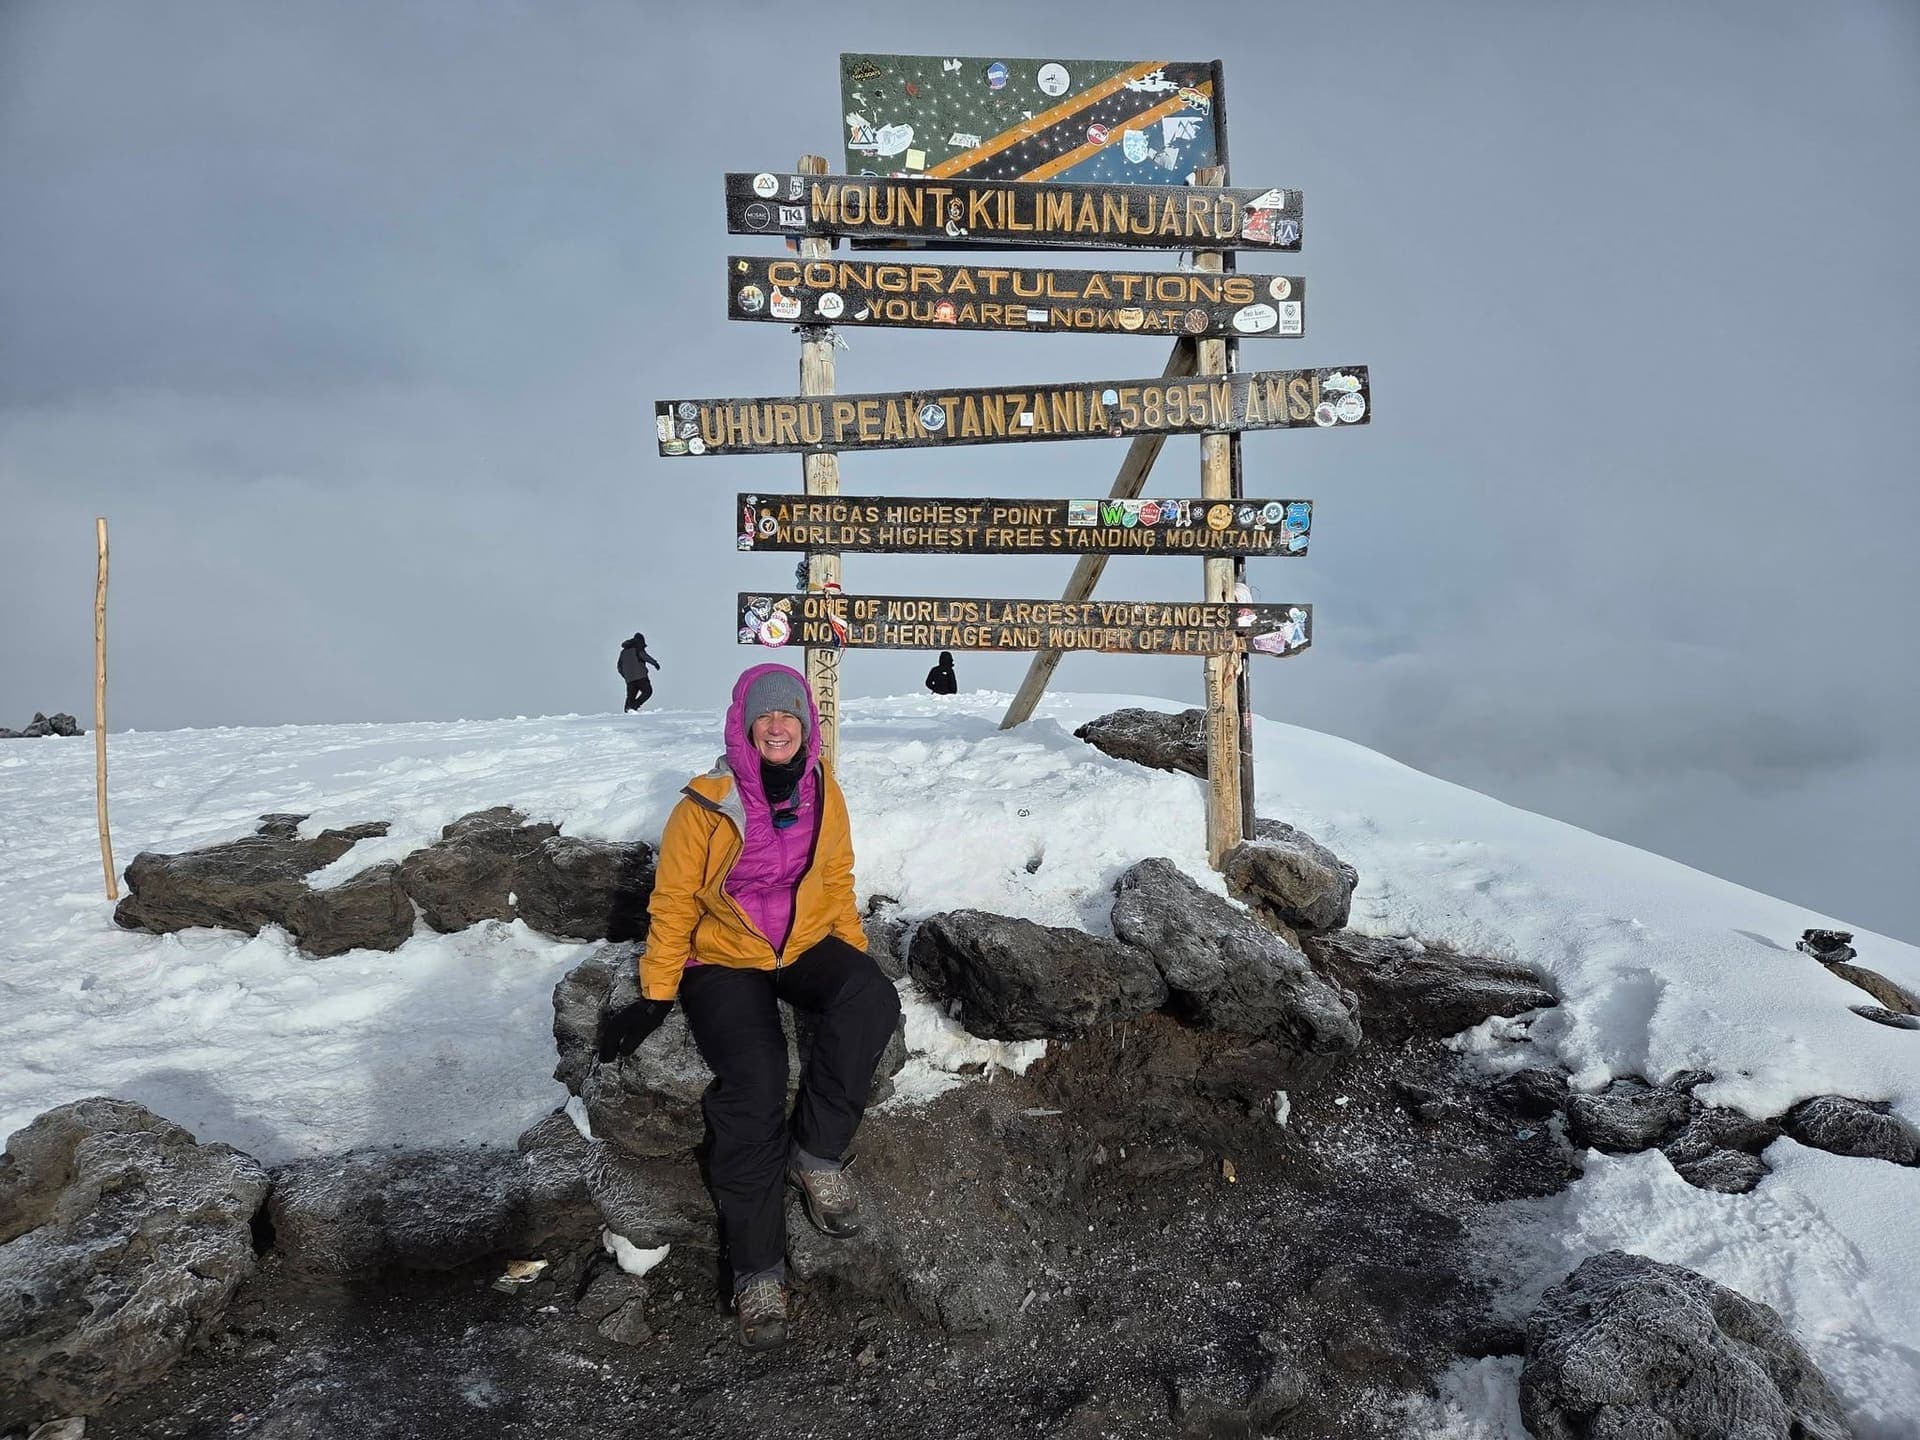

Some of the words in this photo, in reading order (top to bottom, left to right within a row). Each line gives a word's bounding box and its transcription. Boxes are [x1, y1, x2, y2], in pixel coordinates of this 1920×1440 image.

[811, 183, 953, 228] MOUNT
[969, 188, 1237, 238] KILIMANJARO
[768, 261, 1255, 304] CONGRATULATIONS
[866, 298, 934, 322] YOU
[957, 301, 1028, 326] ARE
[1050, 306, 1120, 329] NOW
[1142, 309, 1184, 330] AT
[700, 402, 823, 447] UHURU
[832, 399, 929, 442] PEAK
[938, 390, 1108, 438] TANZANIA
[1118, 382, 1233, 429] 5895M
[777, 503, 880, 523] AFRICAS
[886, 506, 982, 524] HIGHEST
[993, 507, 1057, 525] POINT
[776, 525, 872, 545] WORLD'S
[879, 526, 978, 547] HIGHEST
[985, 528, 1044, 547] FREE
[1050, 528, 1156, 548] STANDING
[1165, 529, 1274, 549] MOUNTAIN
[804, 598, 849, 619] ONE
[854, 599, 881, 620] OF
[887, 600, 980, 623] WORLD'S
[985, 601, 1094, 625] LARGEST
[1098, 603, 1231, 628] VOLCANOES
[803, 621, 877, 644] WOLD
[884, 623, 992, 647] HERITAGE
[998, 627, 1041, 648] AND
[1048, 628, 1133, 650] WONDER
[1139, 629, 1165, 650] OF
